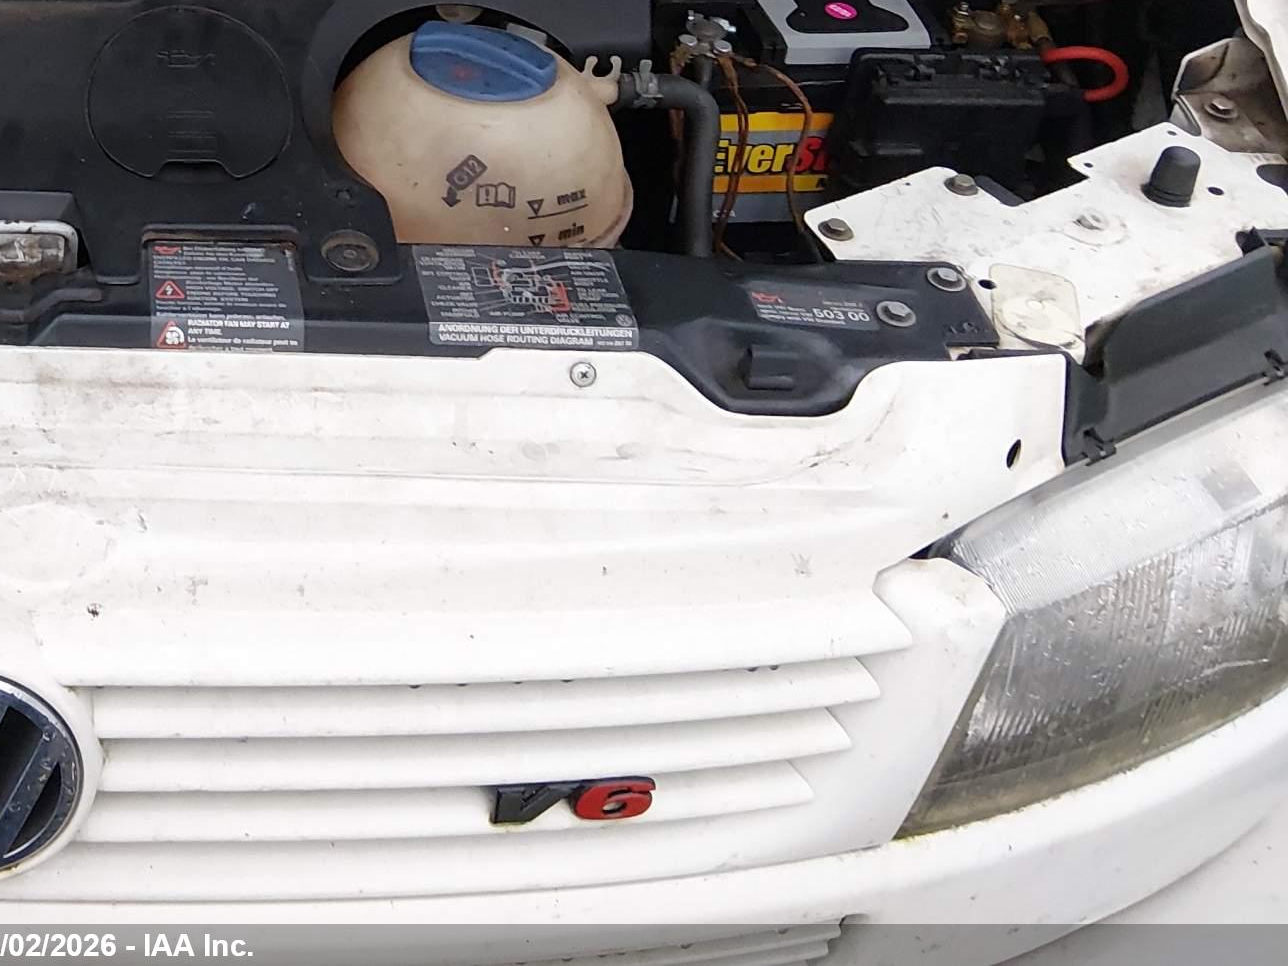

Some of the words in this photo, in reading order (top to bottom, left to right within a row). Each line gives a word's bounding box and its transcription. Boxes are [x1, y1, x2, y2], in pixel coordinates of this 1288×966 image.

[557, 189, 586, 205] max
[558, 223, 584, 241] min
[812, 308, 845, 320] 503
[848, 311, 870, 322] 00
[187, 319, 223, 327] RADIATOR
[240, 320, 256, 328] MAY
[257, 320, 279, 329] START
[280, 321, 290, 329] AT
[439, 325, 498, 334] ANORDNUNG
[500, 326, 518, 334] DER
[520, 326, 632, 338] UNTERDRUCKLEITUNGEN
[440, 333, 481, 342] VACUUM
[482, 334, 505, 343] HOSE
[507, 335, 549, 345] ROUTING
[550, 337, 593, 346] DIAGRAM
[490, 776, 656, 824] V6
